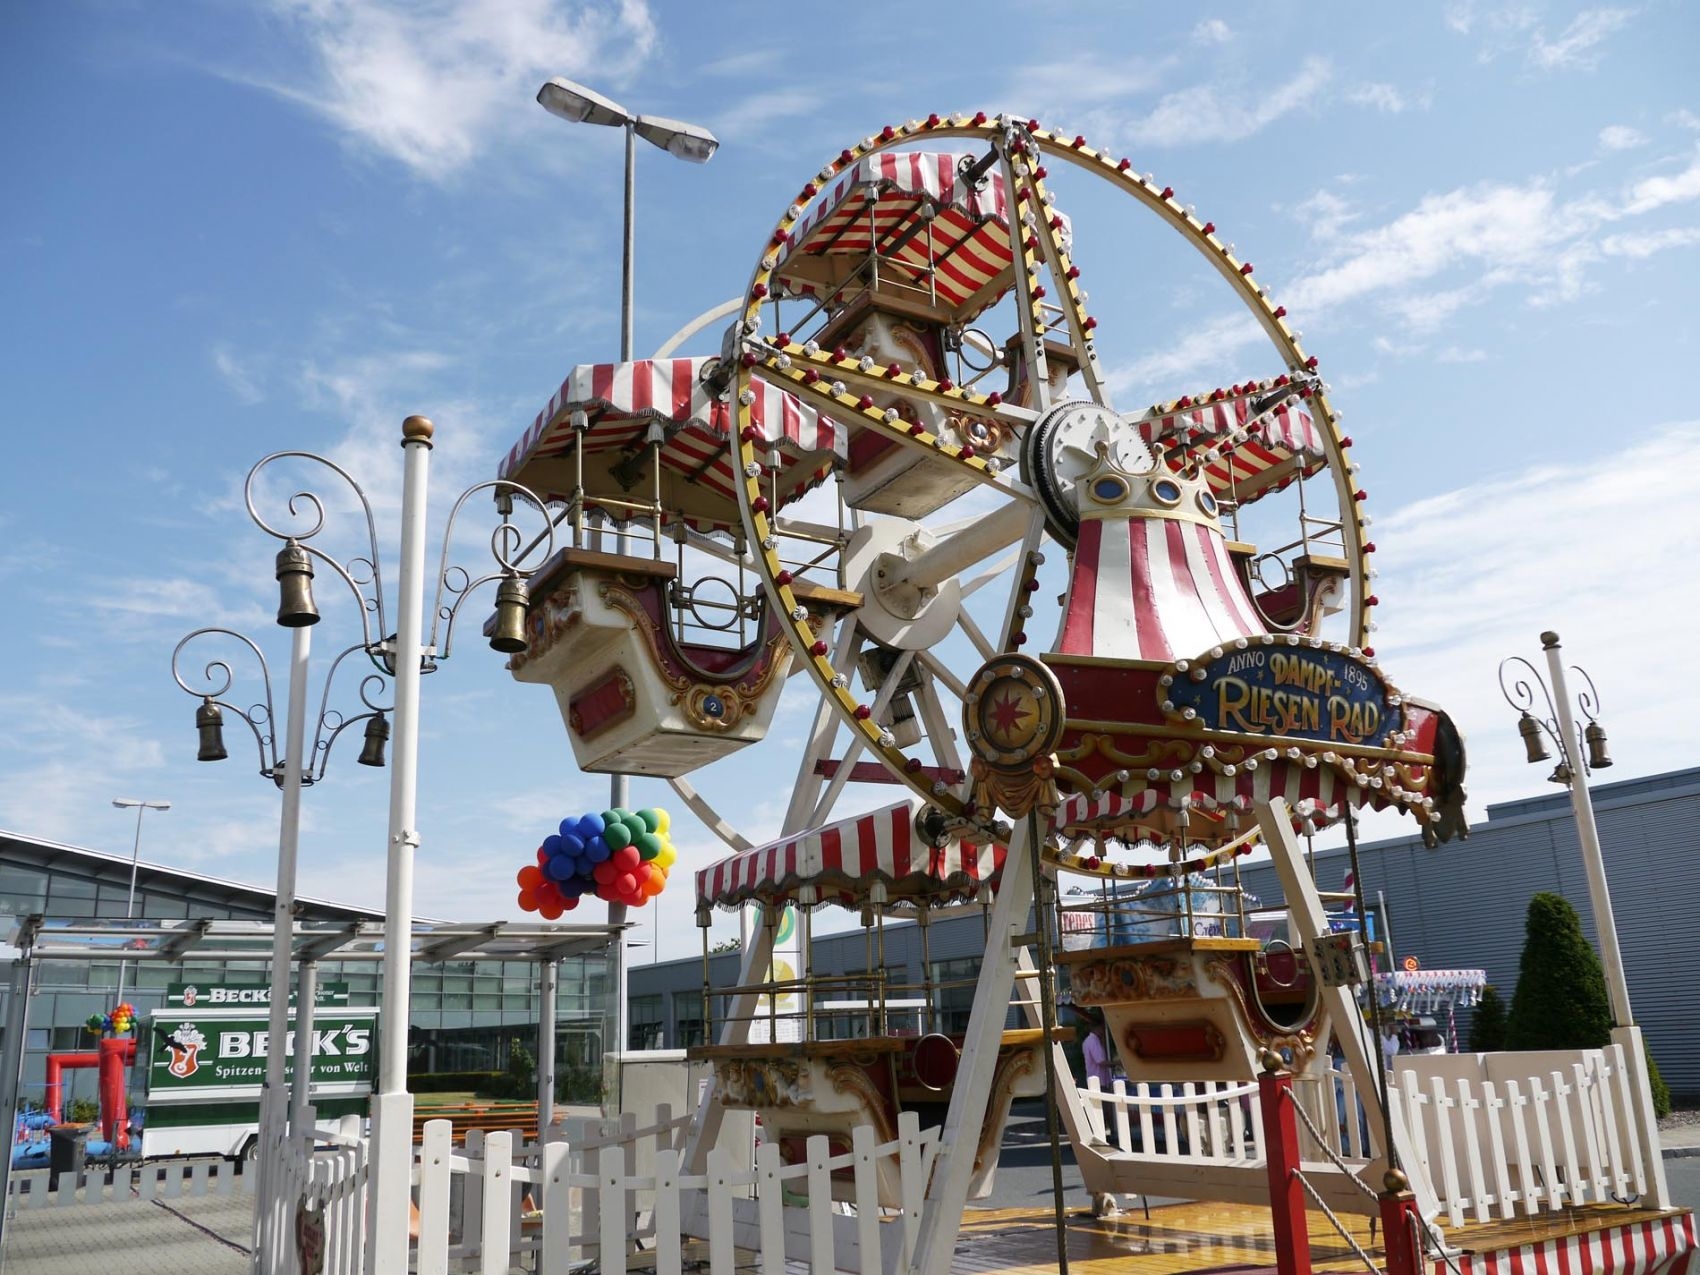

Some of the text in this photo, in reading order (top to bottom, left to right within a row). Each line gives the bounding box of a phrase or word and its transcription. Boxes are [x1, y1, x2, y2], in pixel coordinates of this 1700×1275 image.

[1227, 651, 1368, 691] ANNO 1895
[1269, 652, 1341, 697] DAMPF-
[710, 702, 717, 712] 2
[1212, 675, 1379, 743] RIESEN RAD
[320, 1064, 341, 1074] von
[344, 1061, 369, 1073] Welt
